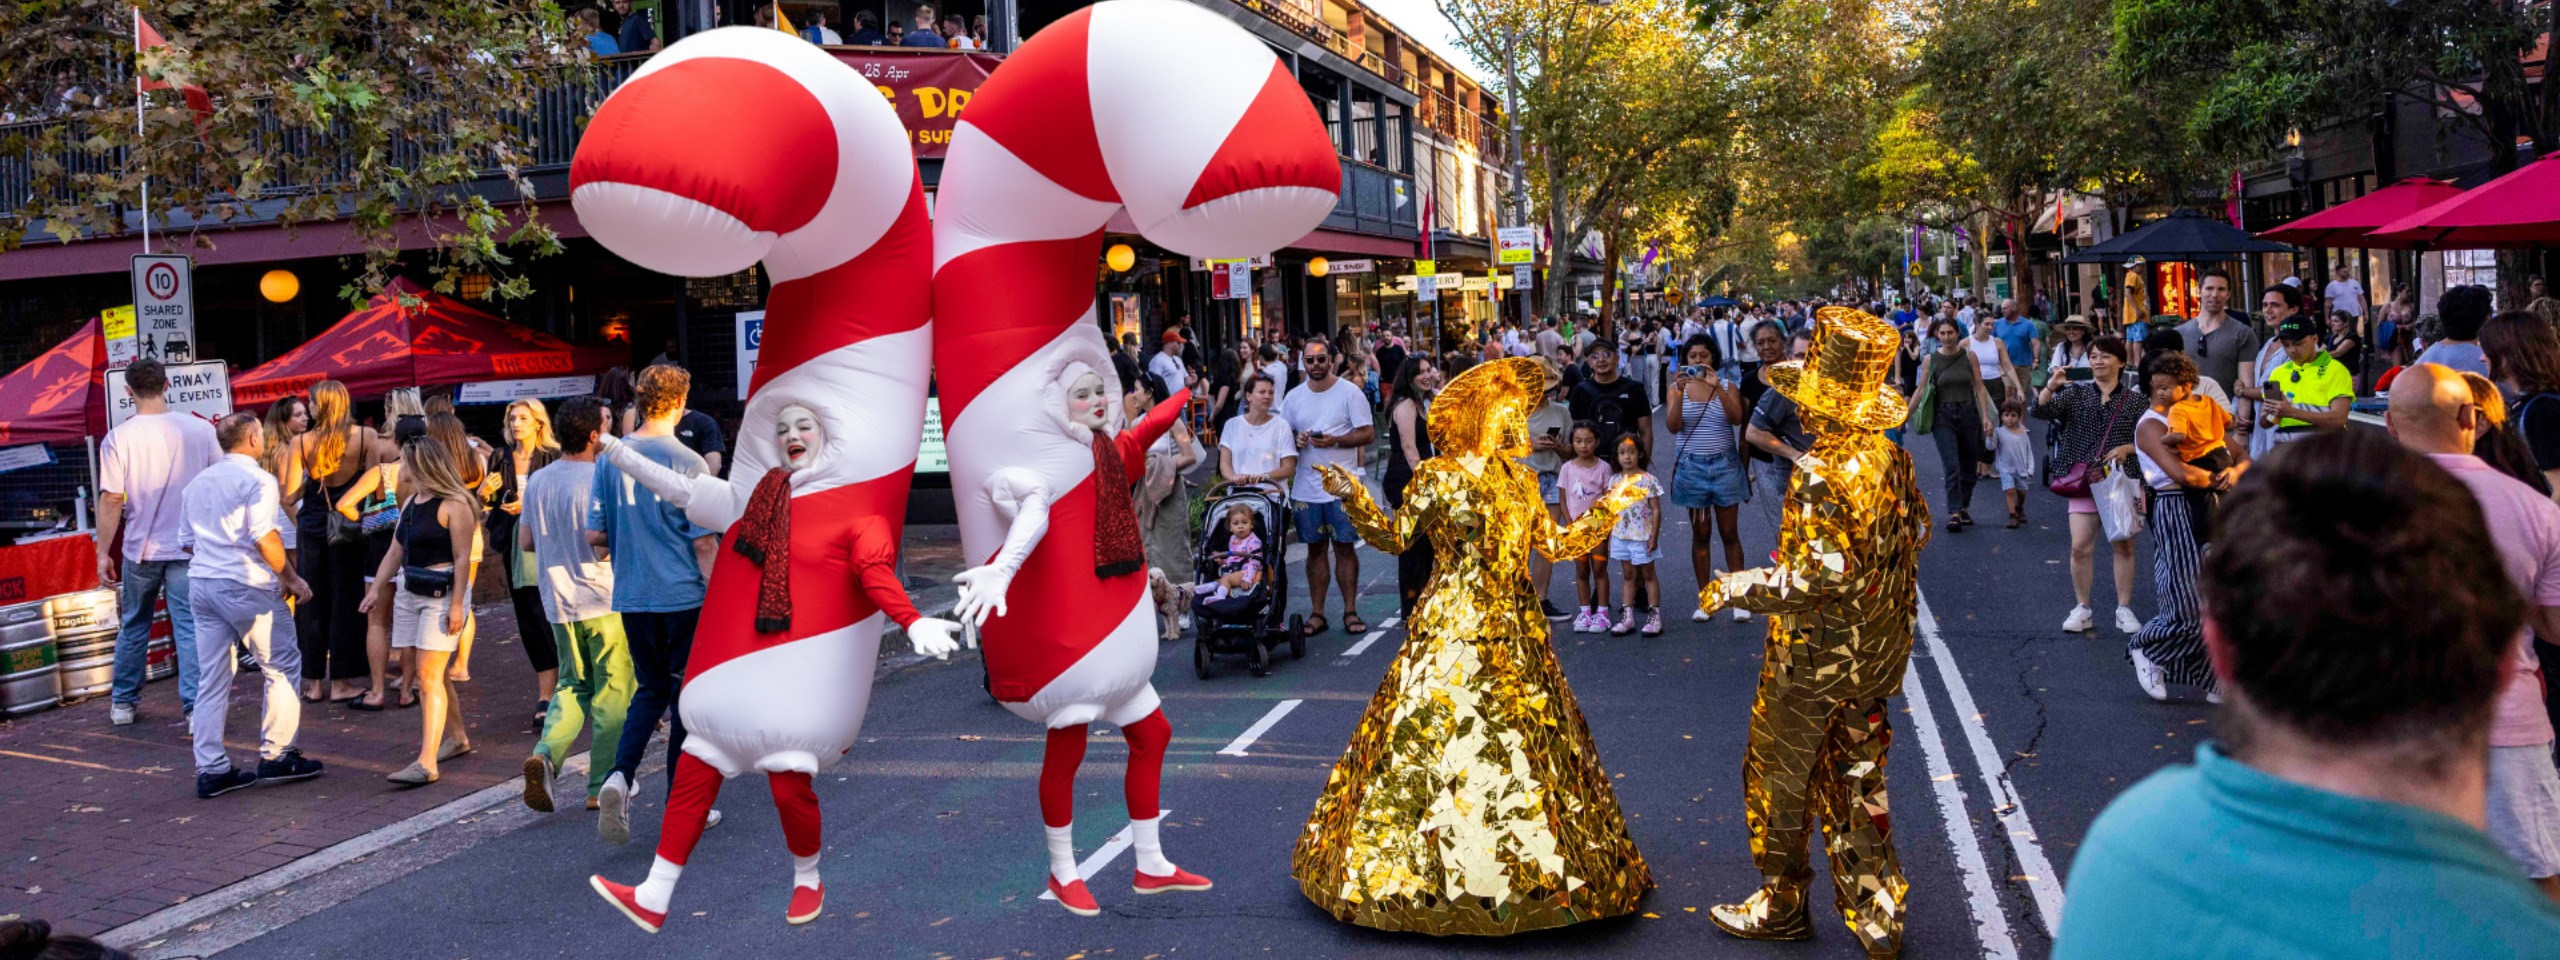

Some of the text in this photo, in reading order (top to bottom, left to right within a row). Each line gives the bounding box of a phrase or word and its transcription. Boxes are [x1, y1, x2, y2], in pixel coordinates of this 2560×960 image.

[884, 65, 910, 82] Apr
[911, 86, 977, 119] DA
[154, 273, 171, 290] 10
[144, 304, 184, 316] SHARED
[152, 318, 178, 330] ZONE
[495, 354, 571, 372] THE CLOCK
[179, 388, 223, 402] EVENTS
[241, 383, 271, 401] THE
